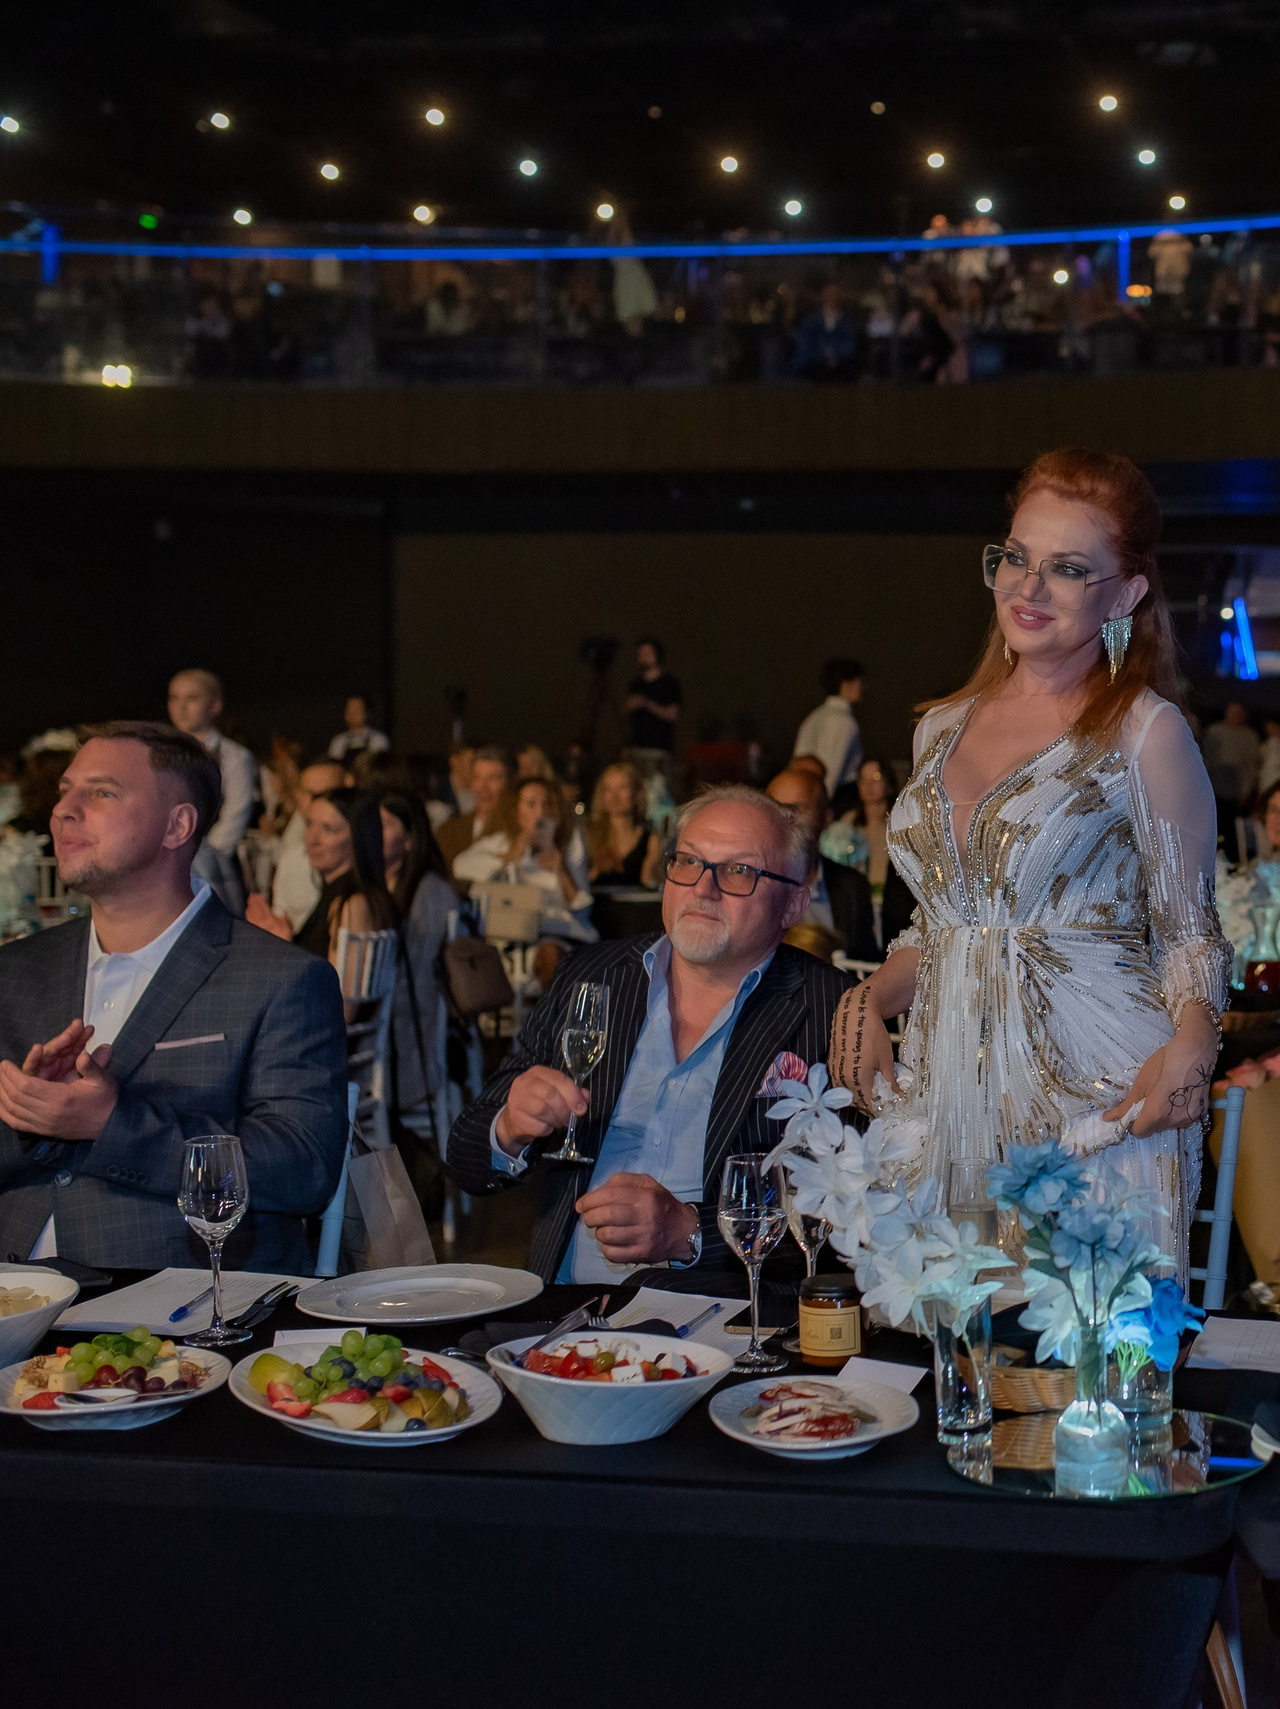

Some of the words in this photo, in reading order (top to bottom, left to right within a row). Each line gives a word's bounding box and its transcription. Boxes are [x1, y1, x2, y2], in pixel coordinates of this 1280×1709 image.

[859, 990, 870, 1005] Love
[857, 1015, 866, 1028] too
[852, 1029, 863, 1053] young
[853, 1054, 862, 1064] to
[853, 1066, 862, 1087] know
